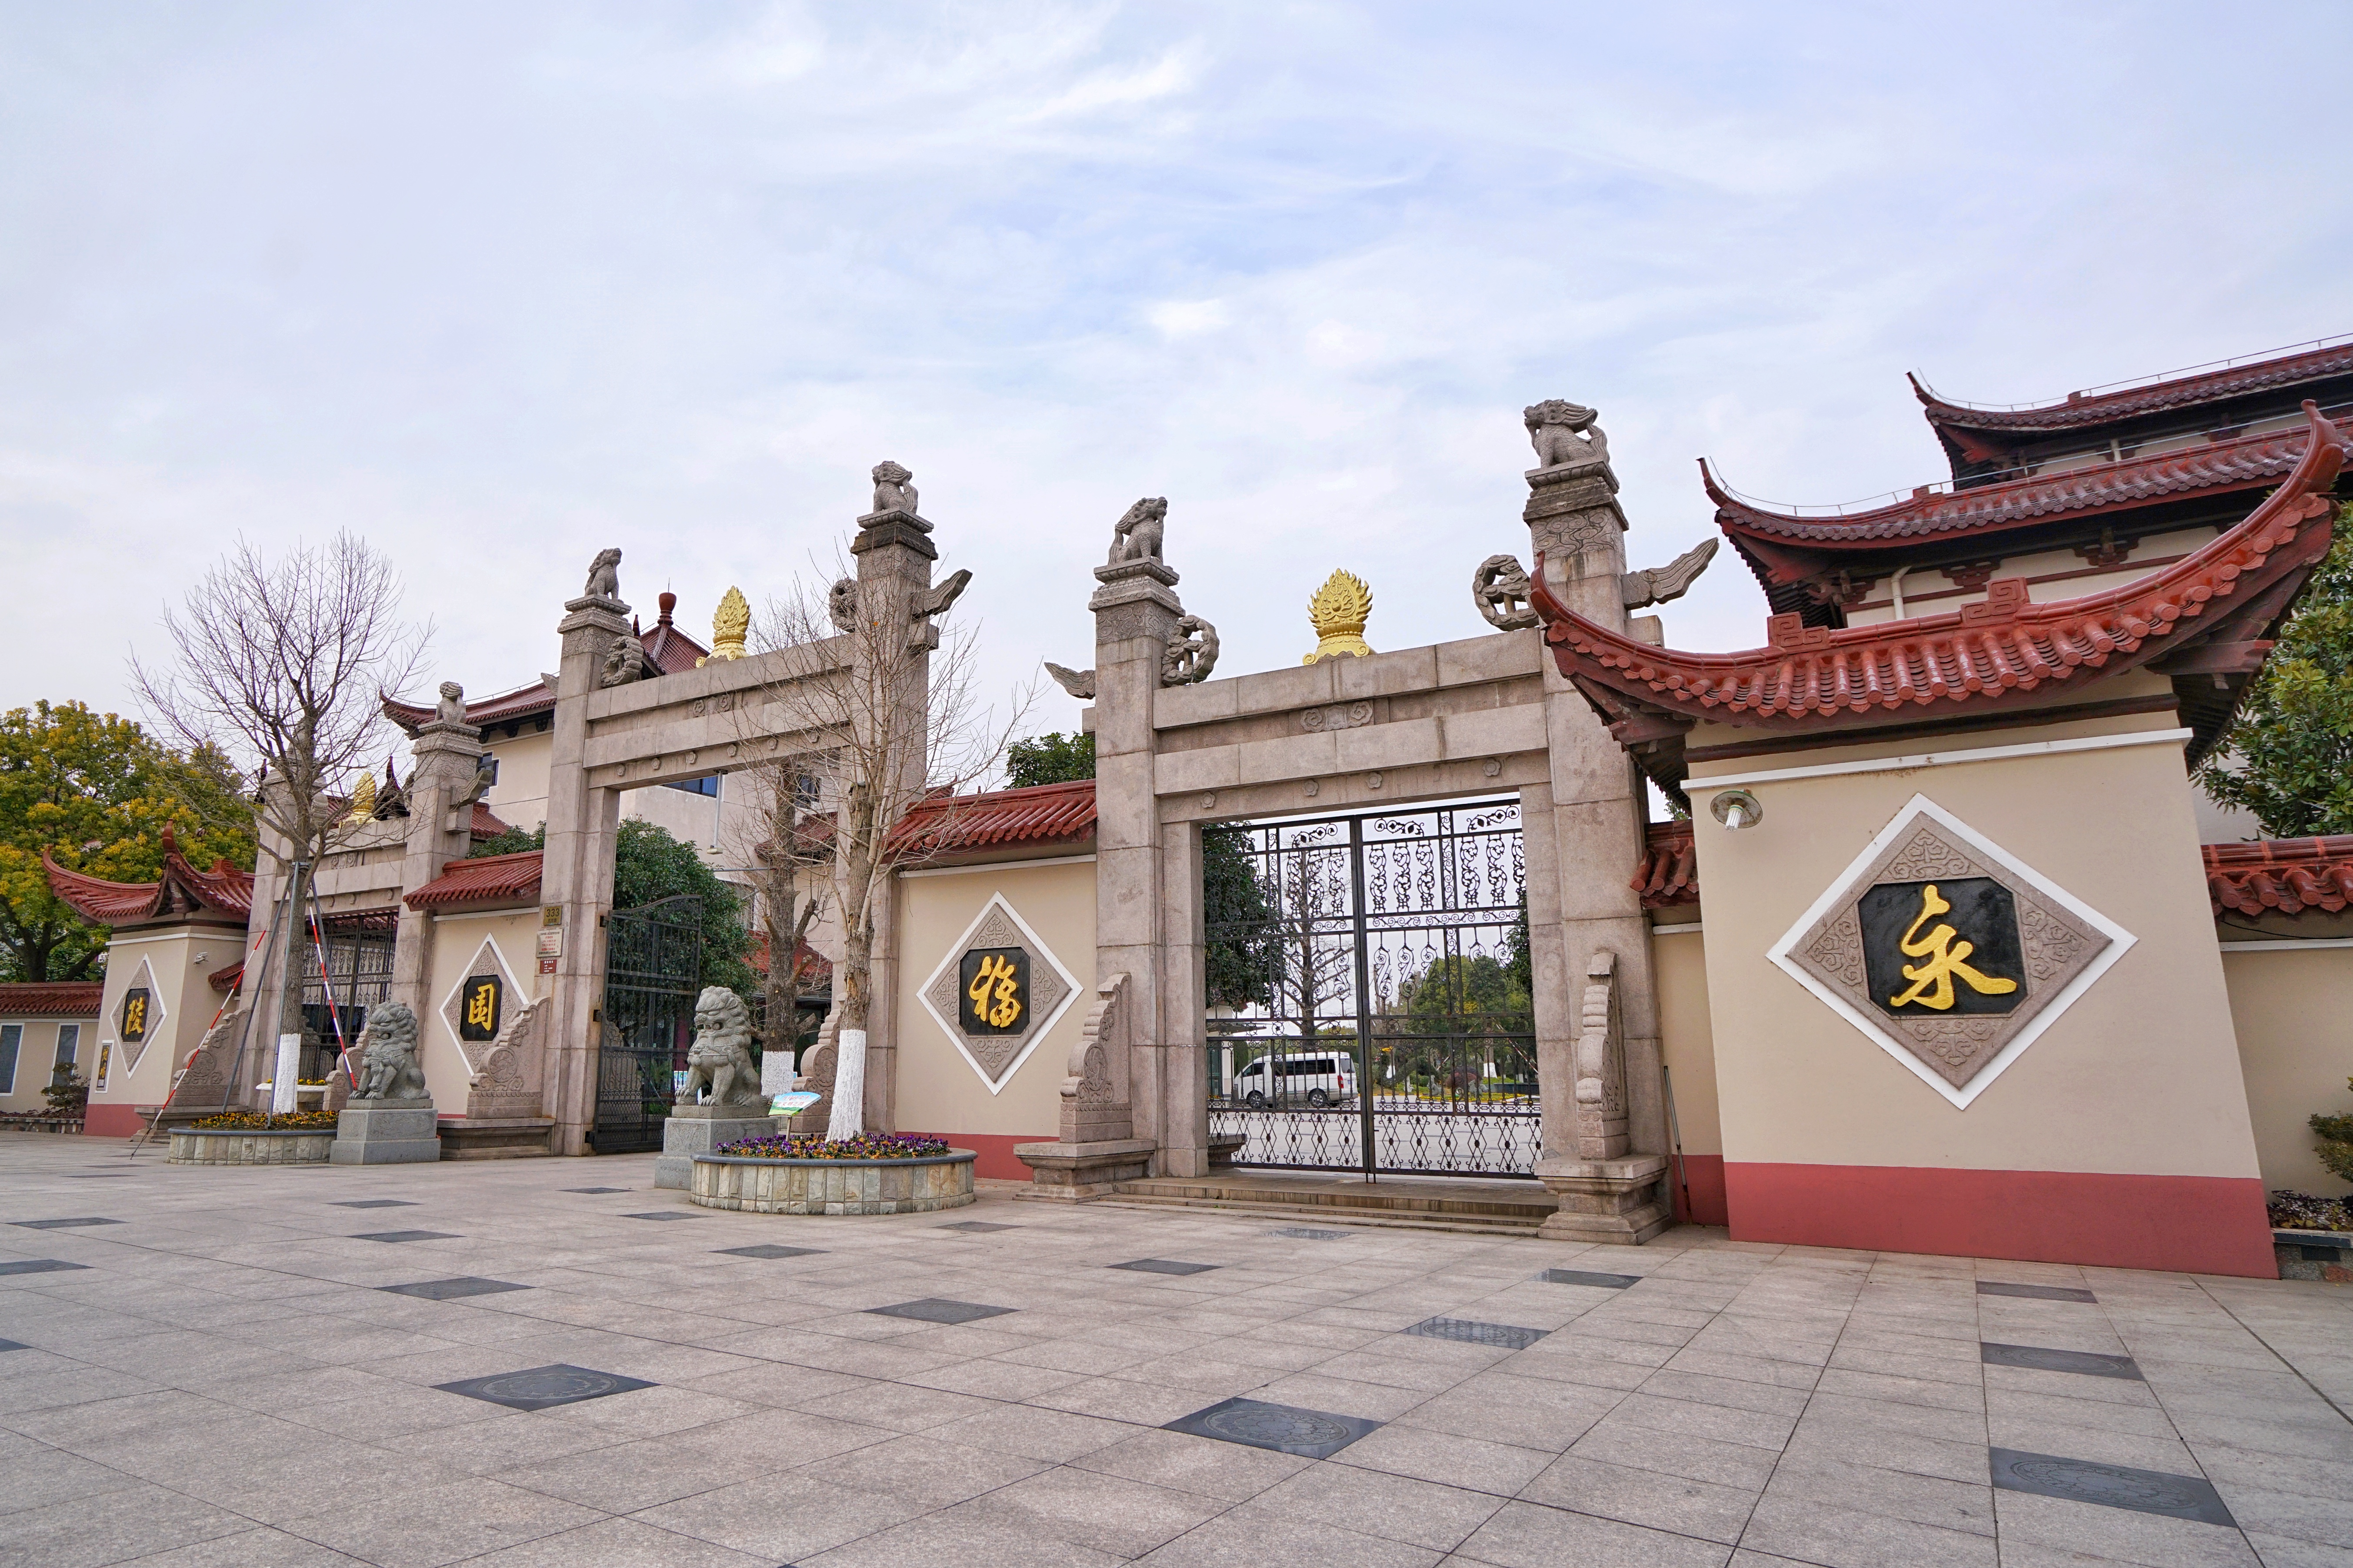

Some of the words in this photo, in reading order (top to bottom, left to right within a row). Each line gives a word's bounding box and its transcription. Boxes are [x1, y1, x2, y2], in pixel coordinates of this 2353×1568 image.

[546, 908, 560, 918] 333
[1891, 885, 2017, 1010] 永
[125, 997, 144, 1035] 陵
[969, 955, 1021, 1028] 福
